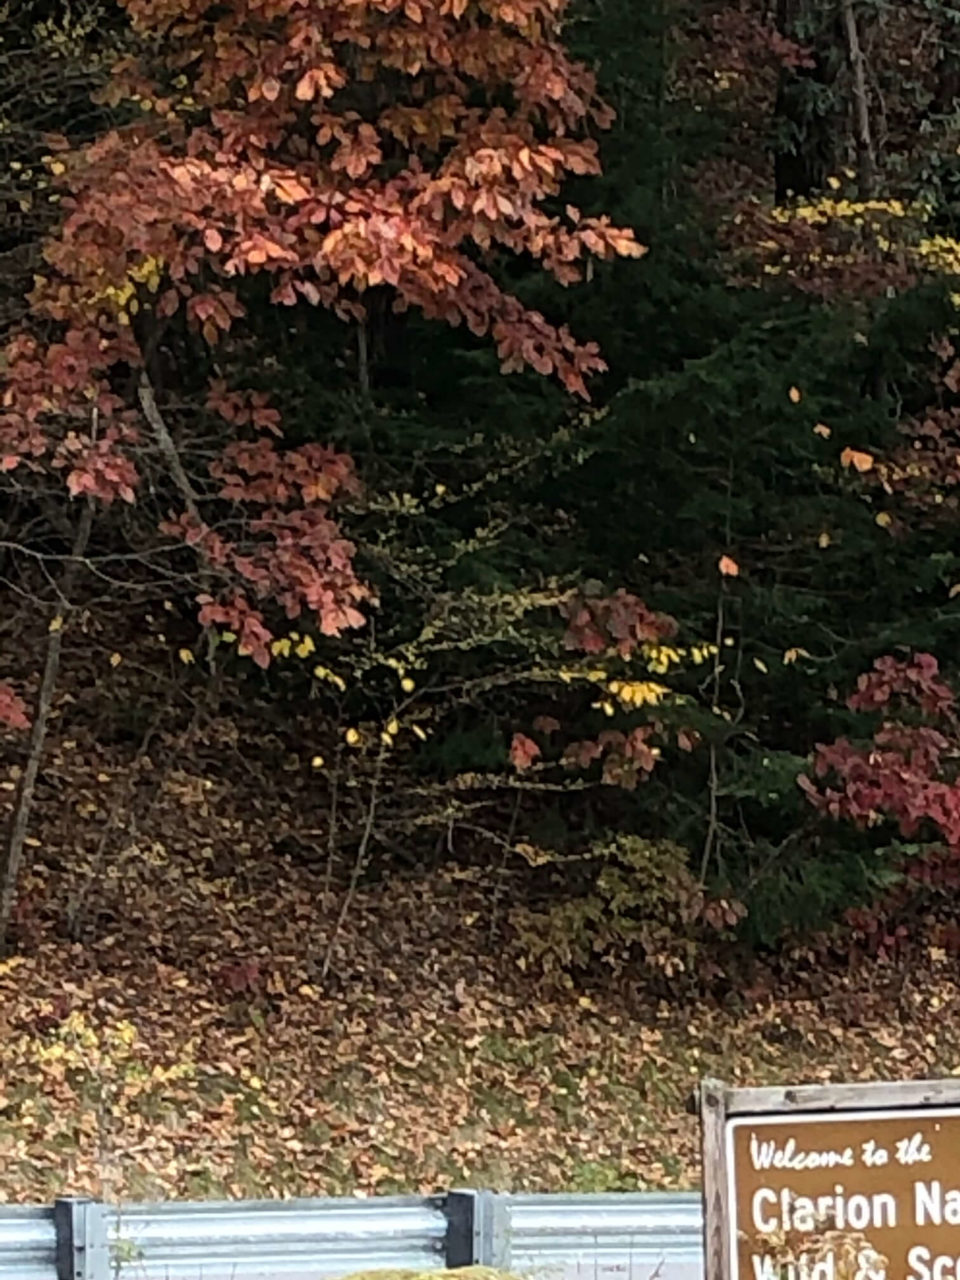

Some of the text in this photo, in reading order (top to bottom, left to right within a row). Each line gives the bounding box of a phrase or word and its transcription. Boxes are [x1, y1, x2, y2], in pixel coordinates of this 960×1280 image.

[750, 1131, 932, 1170] Welcome to the
[752, 1184, 896, 1233] Clarion
